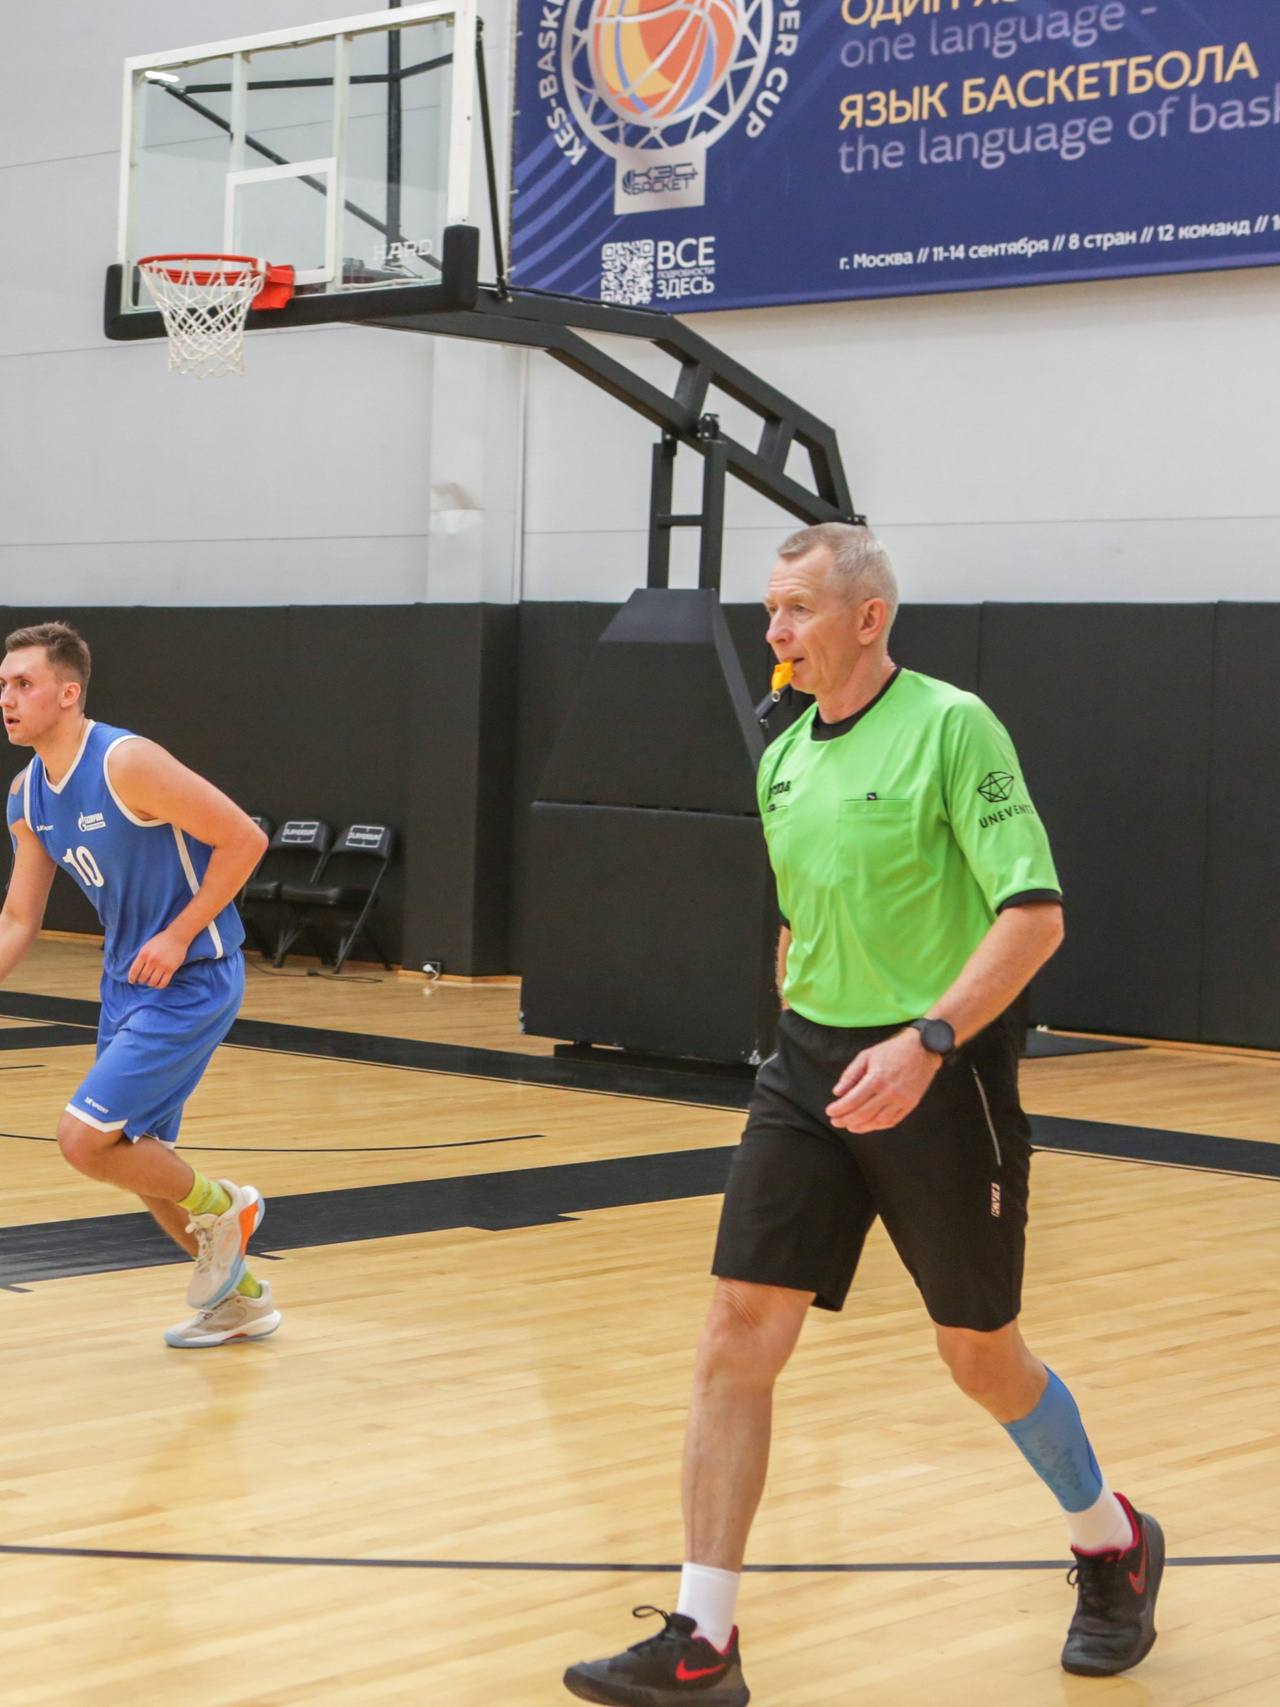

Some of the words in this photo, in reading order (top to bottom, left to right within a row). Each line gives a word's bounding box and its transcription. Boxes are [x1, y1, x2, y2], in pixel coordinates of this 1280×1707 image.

[840, 33, 916, 68] one
[930, 2, 1125, 59] language
[745, 67, 789, 138] CUP
[838, 82, 949, 130] ЯЗЫК
[962, 41, 1260, 115] БАСКЕТБОЛА
[839, 134, 905, 174] the
[919, 115, 1113, 170] language
[1128, 96, 1180, 140] of
[372, 239, 433, 261] HARD
[657, 236, 716, 270] ВСЕ
[839, 257, 850, 270] г.
[853, 250, 914, 269] Москва
[932, 244, 965, 262] 11-14
[968, 236, 1049, 258] сентября
[1068, 233, 1080, 250] 8
[1083, 230, 1137, 251] стран
[1157, 224, 1175, 242] 12
[1178, 219, 1251, 239] команд
[656, 276, 716, 299] ЗДЕСЬ
[62, 845, 105, 888] 10
